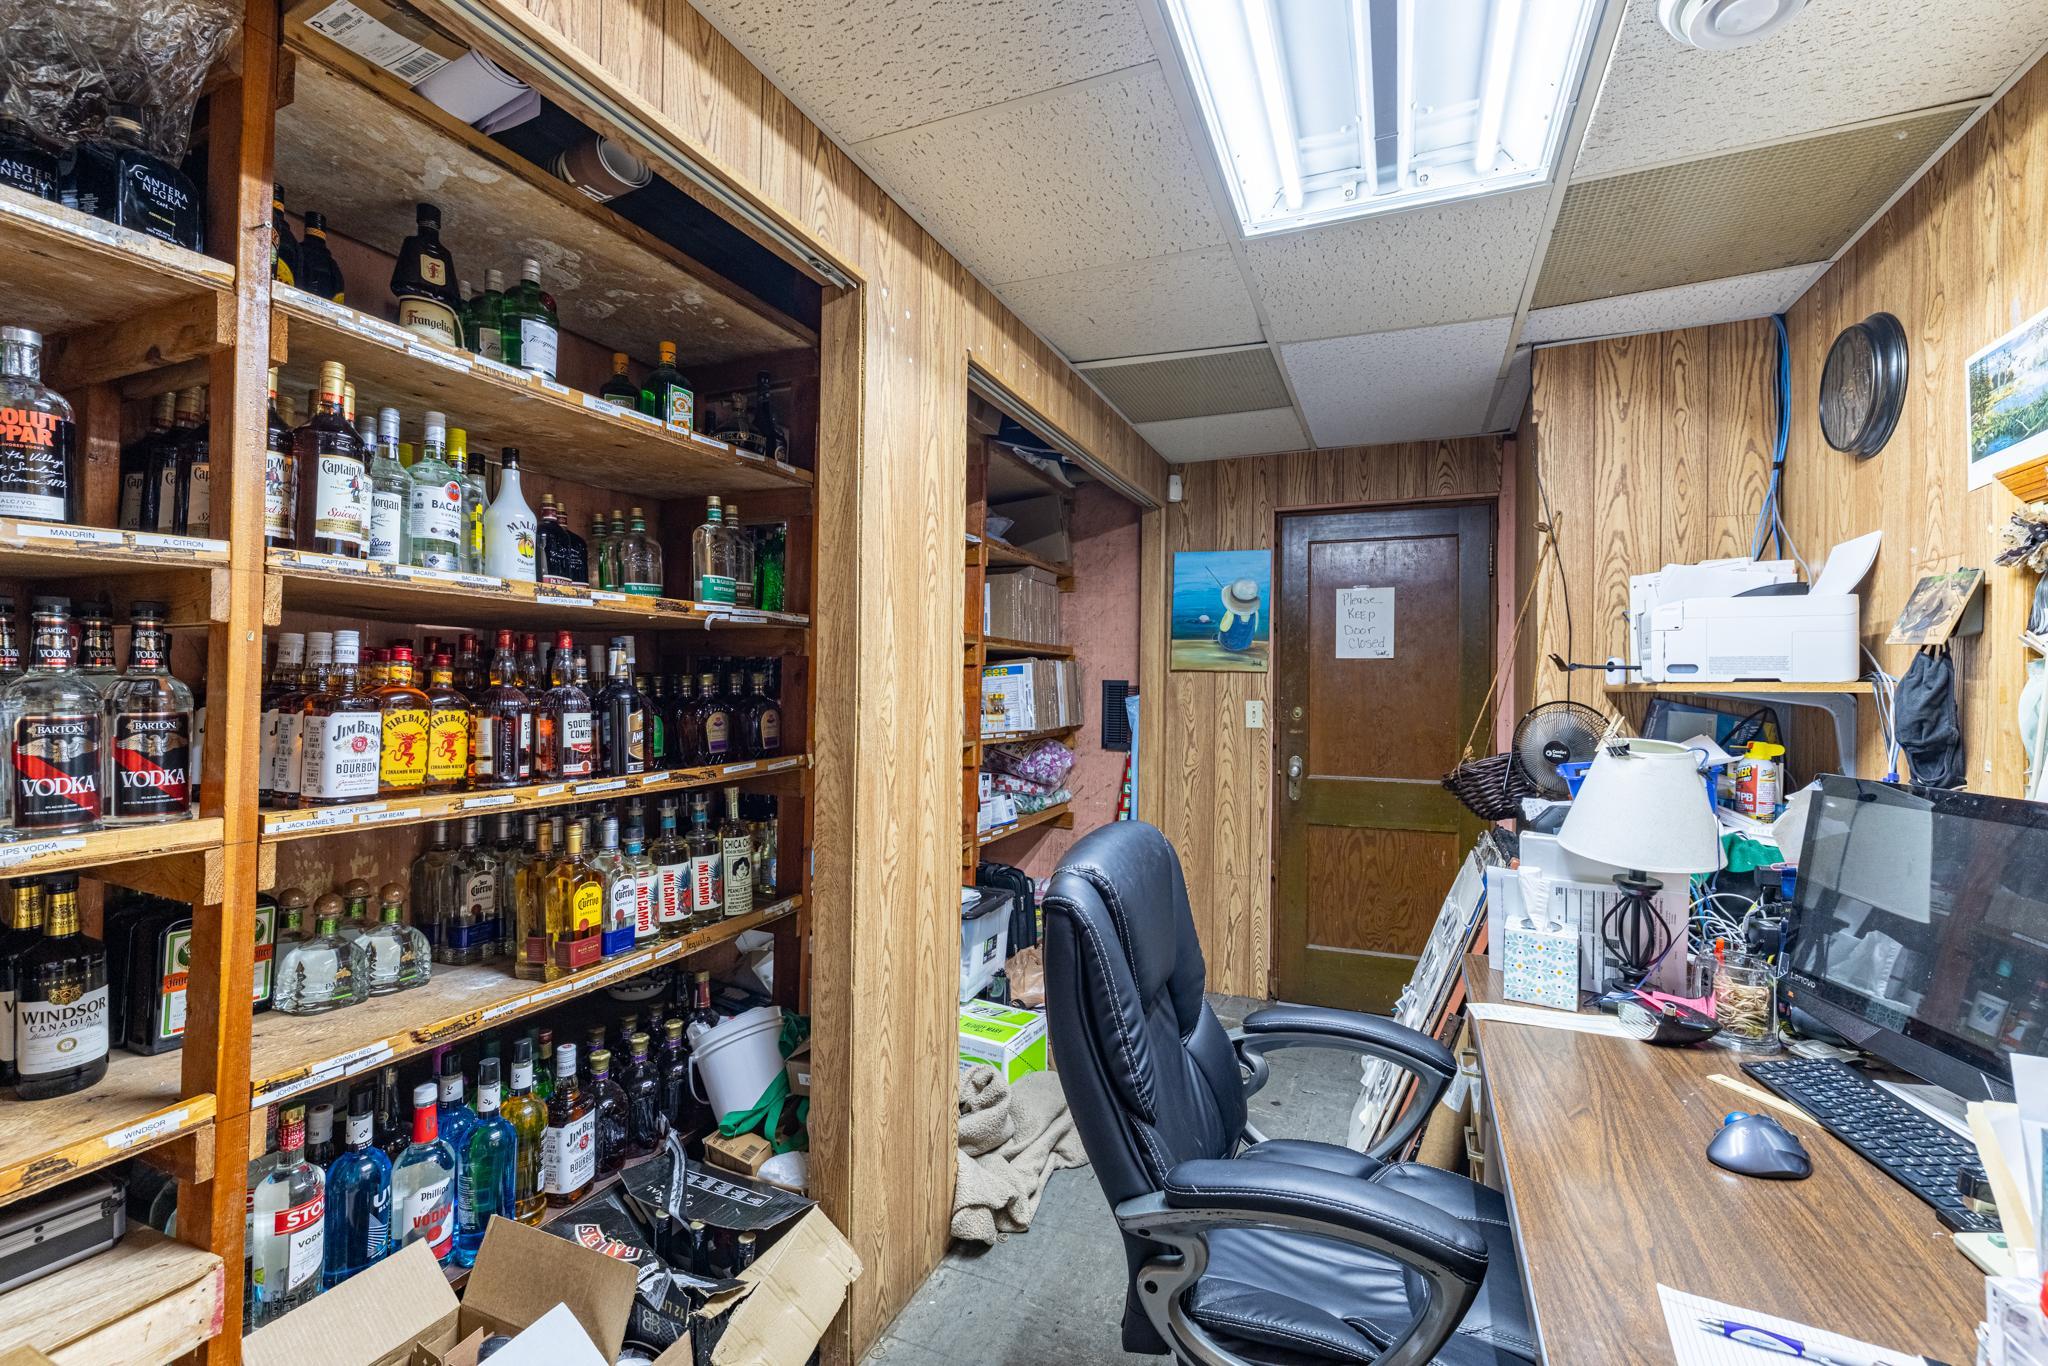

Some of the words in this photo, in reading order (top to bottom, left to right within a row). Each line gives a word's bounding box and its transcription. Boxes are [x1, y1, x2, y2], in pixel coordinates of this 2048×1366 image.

[0, 158, 57, 183] ANTERA
[135, 170, 188, 203] CANTERA
[142, 181, 182, 207] NEGRA
[0, 406, 62, 432] OLUT
[322, 459, 356, 476] Captain
[50, 528, 95, 540] MANDRIN
[506, 520, 536, 534] MALI
[173, 539, 204, 548] CITRON
[321, 558, 349, 567] CAPTAIN
[1344, 624, 1376, 636] Door
[1348, 636, 1385, 649] Closed
[39, 649, 71, 658] VODKA
[135, 650, 163, 659] VODKA
[134, 720, 177, 731] BARTON
[384, 713, 429, 731] FIREBALL
[431, 713, 469, 730] FIREBALL
[37, 723, 84, 736] BARTON
[332, 724, 355, 742] JIM
[355, 719, 381, 735] BEAM
[335, 760, 378, 774] BOURBON
[120, 768, 186, 789] VODKA
[21, 777, 96, 798] VODKA
[338, 806, 355, 815] JACK
[378, 812, 388, 820] JIM
[389, 810, 405, 819] BEAM
[287, 821, 306, 830] JACK
[306, 817, 336, 827] DANIEL'S
[22, 841, 58, 853] VODKA
[724, 838, 742, 851] CHICA
[470, 883, 493, 898] Cuervo
[614, 888, 635, 902] Cuervo
[577, 895, 599, 911] Cuervo
[685, 936, 712, 950] Tequila
[38, 973, 92, 986] IMPORTED
[22, 996, 106, 1026] WINDSOR
[29, 1011, 100, 1033] CANADIAN
[332, 1052, 358, 1066] JOHNNY
[358, 1047, 371, 1056] RED
[364, 1057, 377, 1067] JAG
[276, 1082, 302, 1097] JOHNNY
[303, 1074, 325, 1087] BLACK
[124, 1119, 166, 1140] WINDSOR
[566, 1127, 581, 1147] JIM
[420, 1184, 450, 1202] Phillips
[413, 1203, 453, 1229] VODKA
[581, 1225, 640, 1259] BAILEYS
